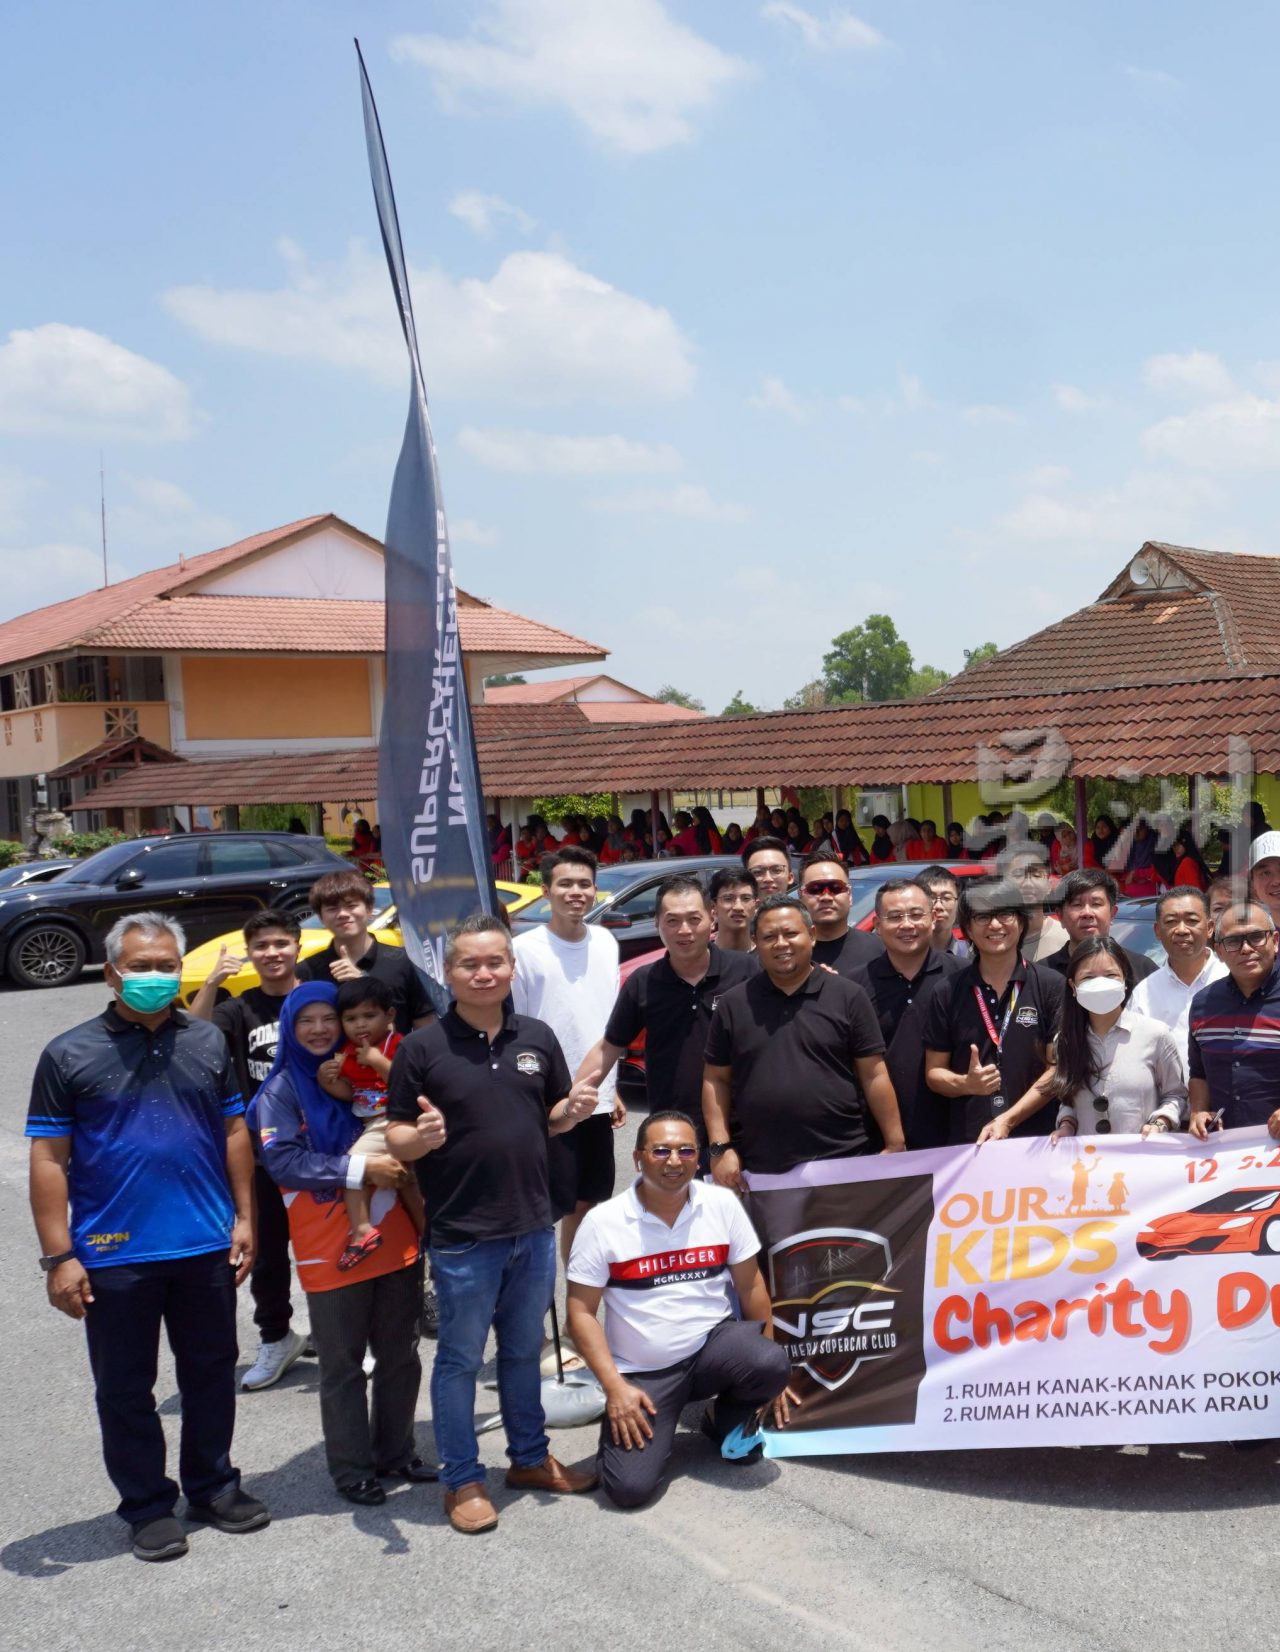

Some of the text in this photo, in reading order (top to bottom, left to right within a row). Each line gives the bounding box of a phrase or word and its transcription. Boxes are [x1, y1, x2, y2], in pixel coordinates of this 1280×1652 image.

[939, 1186, 1050, 1229] OUR
[638, 1250, 715, 1274] HILFIGER
[933, 1221, 1120, 1289] KIDS
[772, 1300, 895, 1338] NSC
[932, 1278, 1192, 1355] Charity
[819, 1336, 868, 1354] SUPERCAR
[871, 1333, 897, 1350] CLUB
[1036, 1374, 1197, 1396] KANAK-KANAK
[1035, 1398, 1198, 1419] KANAK-KANAK
[1204, 1394, 1269, 1413] ARAU
